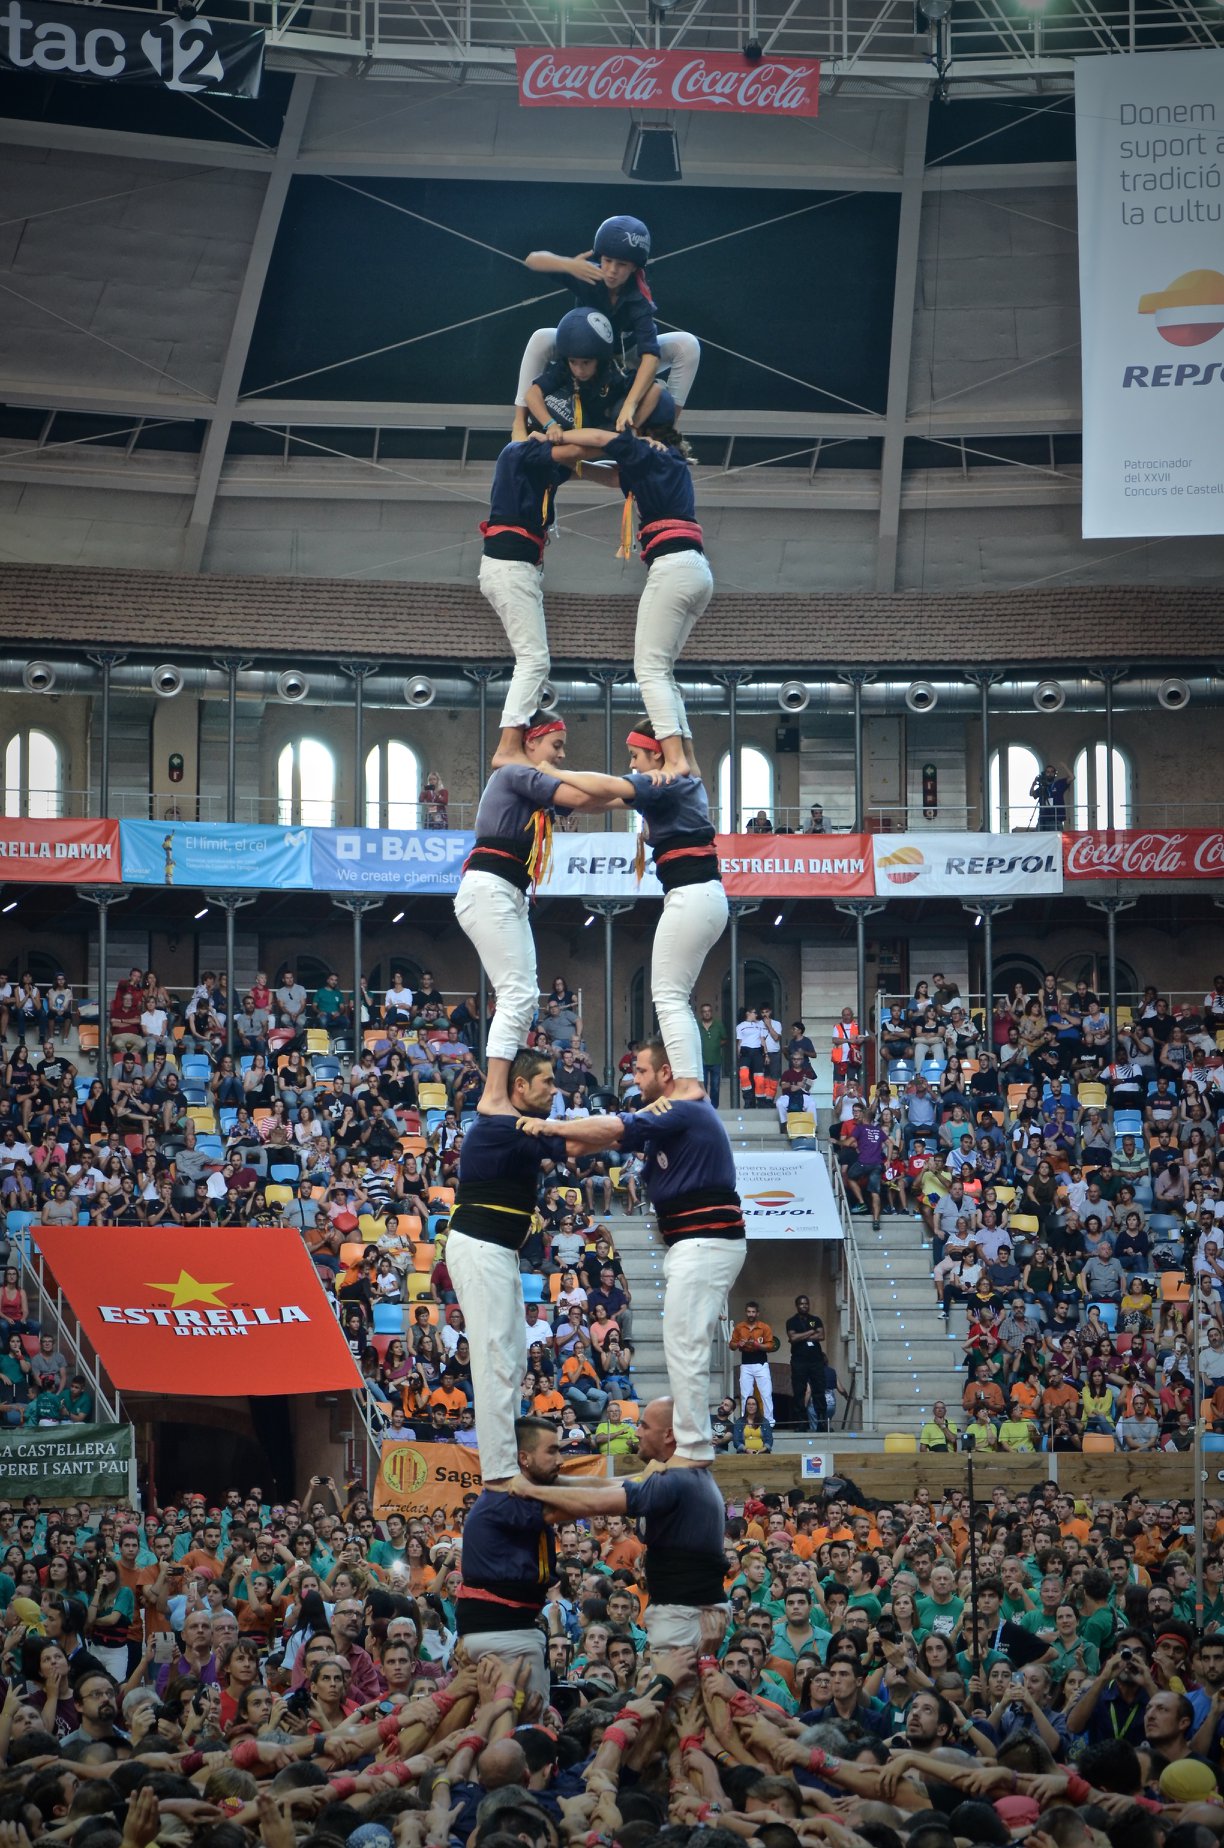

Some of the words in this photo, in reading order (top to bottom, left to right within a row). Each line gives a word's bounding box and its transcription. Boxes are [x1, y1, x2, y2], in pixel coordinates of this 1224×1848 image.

[0, 1, 126, 77] tac
[143, 19, 223, 91] 12
[522, 54, 665, 100] Coca-Cola
[671, 59, 815, 109] Coca-Cola
[1120, 103, 1215, 125] Donem
[1120, 133, 1207, 163] suport
[1120, 163, 1221, 191] tradició
[1122, 201, 1145, 225] la
[1154, 199, 1221, 224] cultu
[1122, 363, 1224, 388] REPS
[546, 400, 575, 423] SERRALLO
[1124, 457, 1193, 470] Patrocinador
[1124, 473, 1141, 483] del
[1144, 472, 1171, 482] XXVII
[1124, 486, 1168, 497] Concurs
[1170, 485, 1184, 496] de
[55, 842, 112, 859] DAMM
[185, 836, 197, 849] El
[199, 836, 232, 853] límit,
[234, 838, 246, 851] el
[249, 839, 267, 852] cel
[382, 837, 465, 862] BASF
[1066, 833, 1189, 873] Coca-Cola
[1194, 834, 1224, 872] Co
[720, 858, 805, 874] ESTRELLA
[808, 858, 865, 874] DAMM
[944, 855, 1057, 875] REPSOL
[337, 869, 357, 881] We
[361, 870, 401, 882] create
[97, 1306, 311, 1326] ESTRELLA
[173, 1326, 249, 1336] DAMM
[17, 1442, 117, 1458] CASTELLERA
[0, 1462, 39, 1476] PERE
[43, 1462, 48, 1476] I
[52, 1461, 94, 1475] SANT
[99, 1460, 129, 1474] PAU
